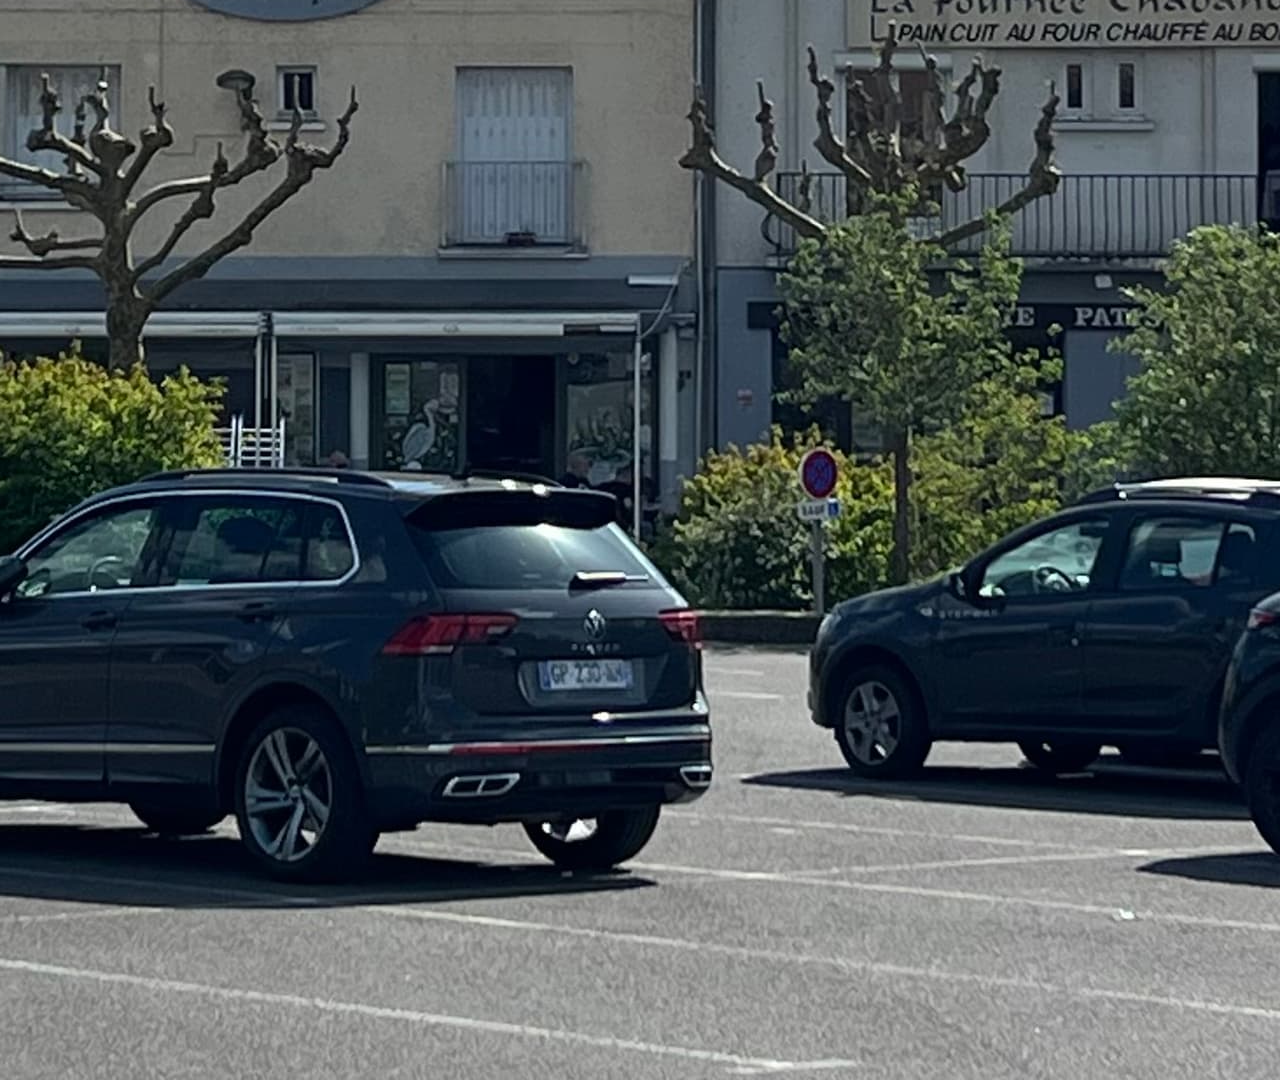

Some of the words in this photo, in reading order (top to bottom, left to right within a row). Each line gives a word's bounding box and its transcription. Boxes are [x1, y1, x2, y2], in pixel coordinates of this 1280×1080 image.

[897, 23, 948, 42] PAIN
[949, 23, 1001, 42] CUIT
[1005, 23, 1036, 42] AU
[1040, 23, 1102, 42] FOUR
[1212, 23, 1243, 42] AU
